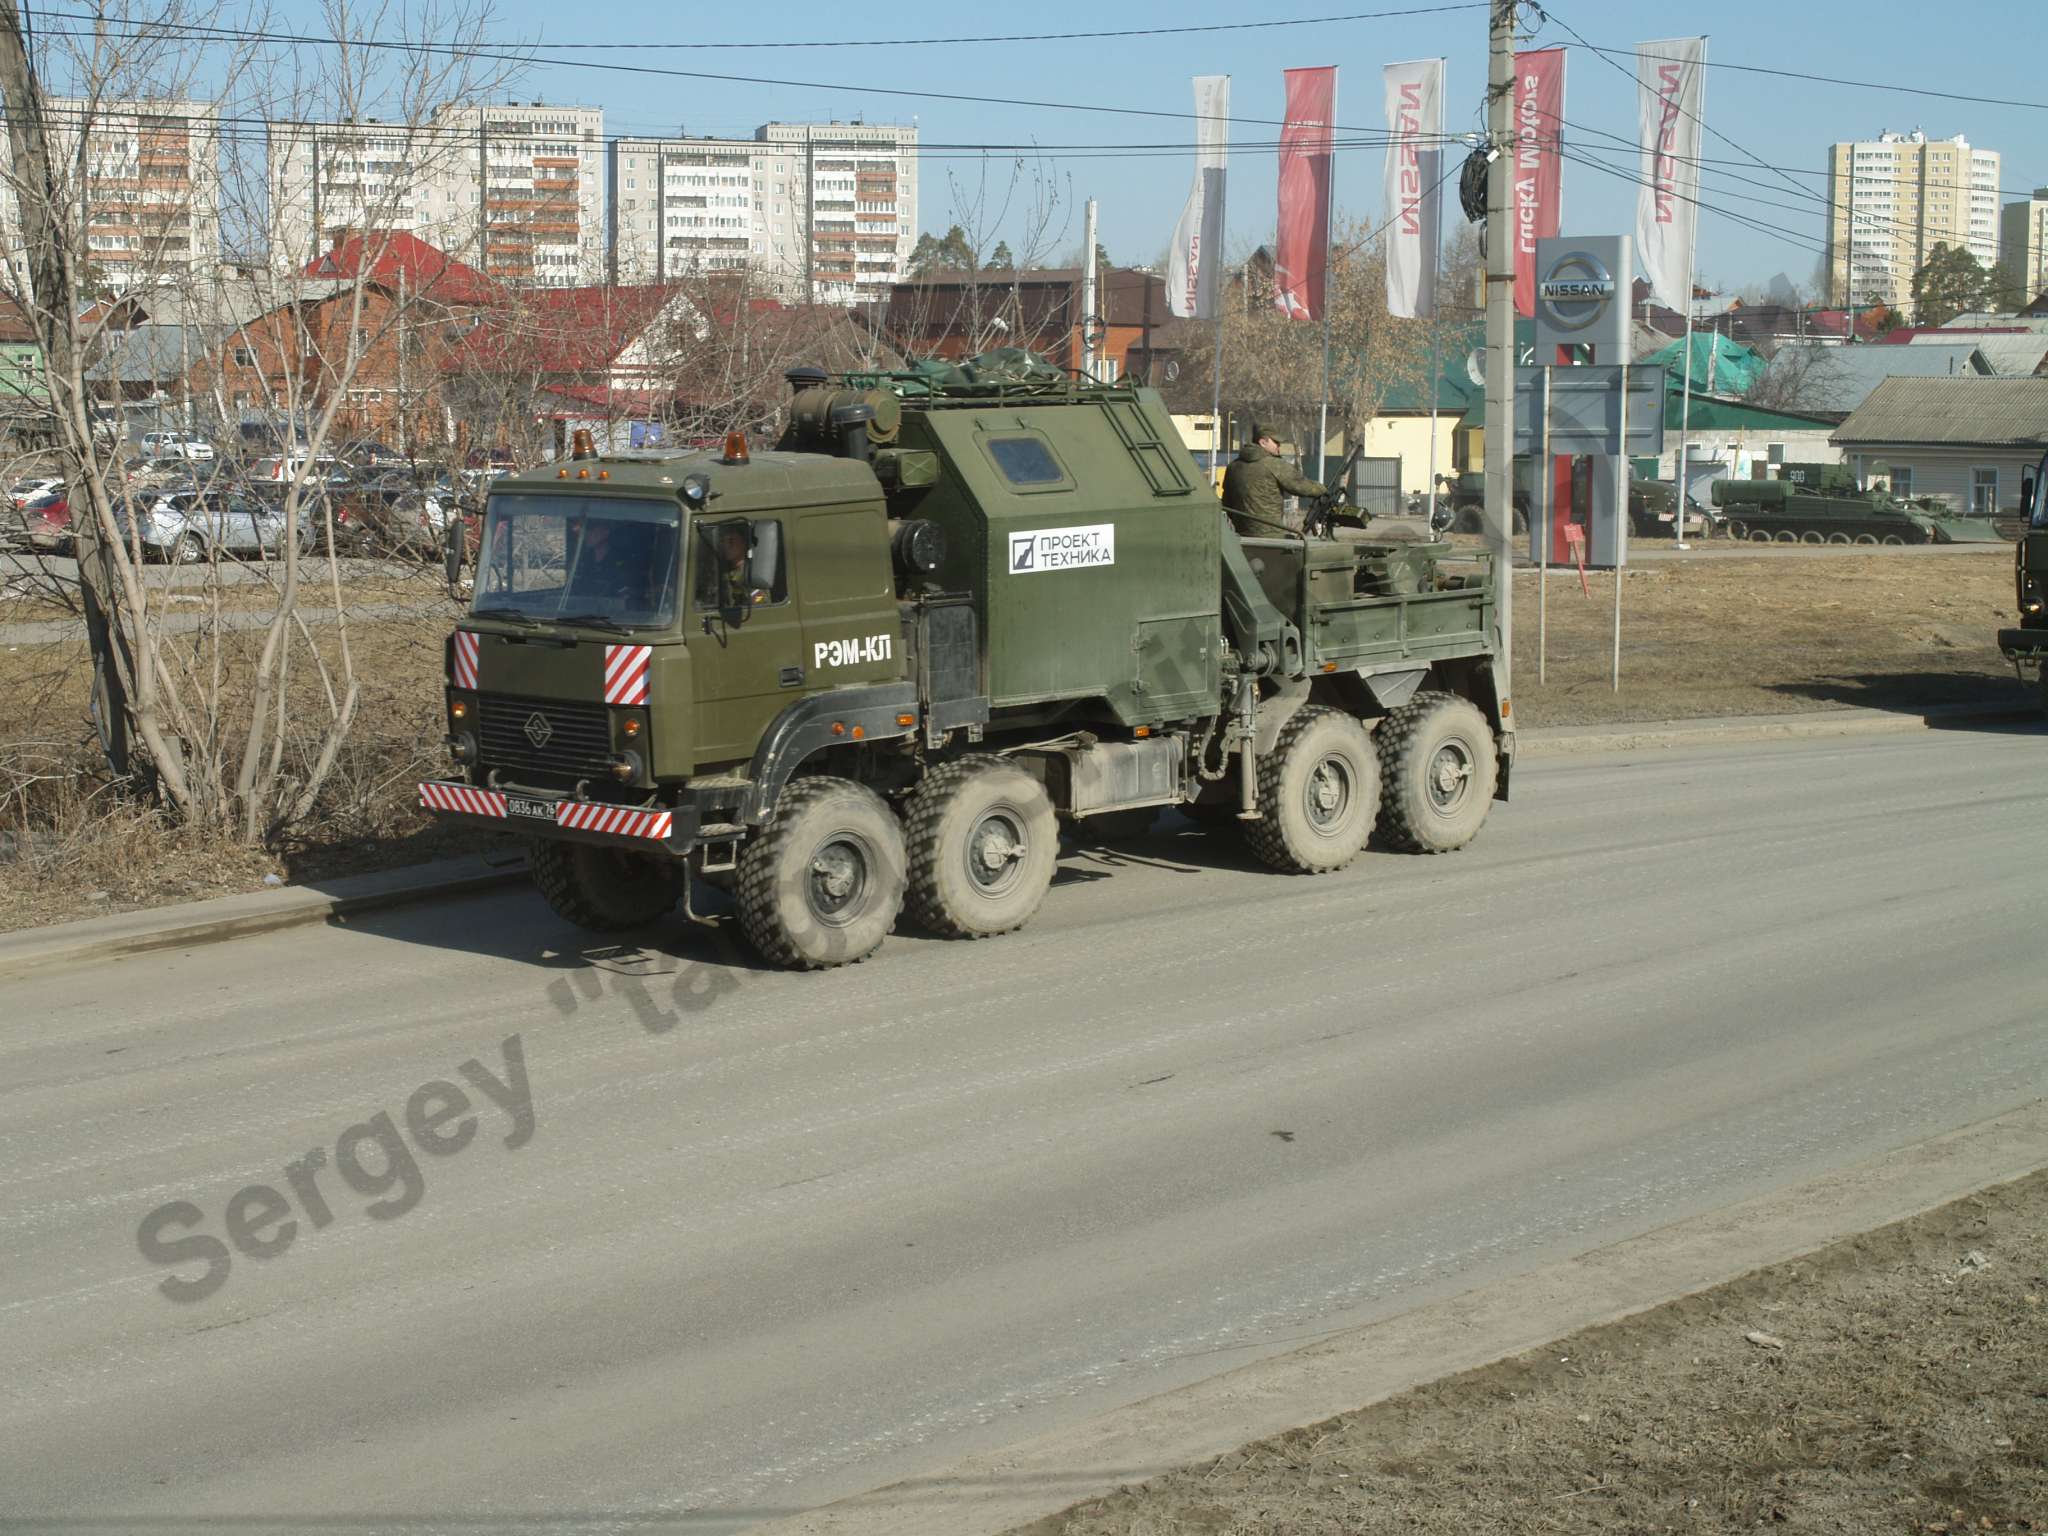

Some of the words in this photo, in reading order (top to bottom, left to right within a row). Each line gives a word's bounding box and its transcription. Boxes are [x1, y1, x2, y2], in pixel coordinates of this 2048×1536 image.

[1544, 284, 1604, 297] NISSAN
[1790, 470, 1805, 482] 900
[1040, 532, 1100, 551] ПРОЕКТ
[1040, 548, 1111, 568] ТЕХНИКА
[814, 633, 892, 669] РЭМ-КЛ
[509, 799, 531, 815] 0836
